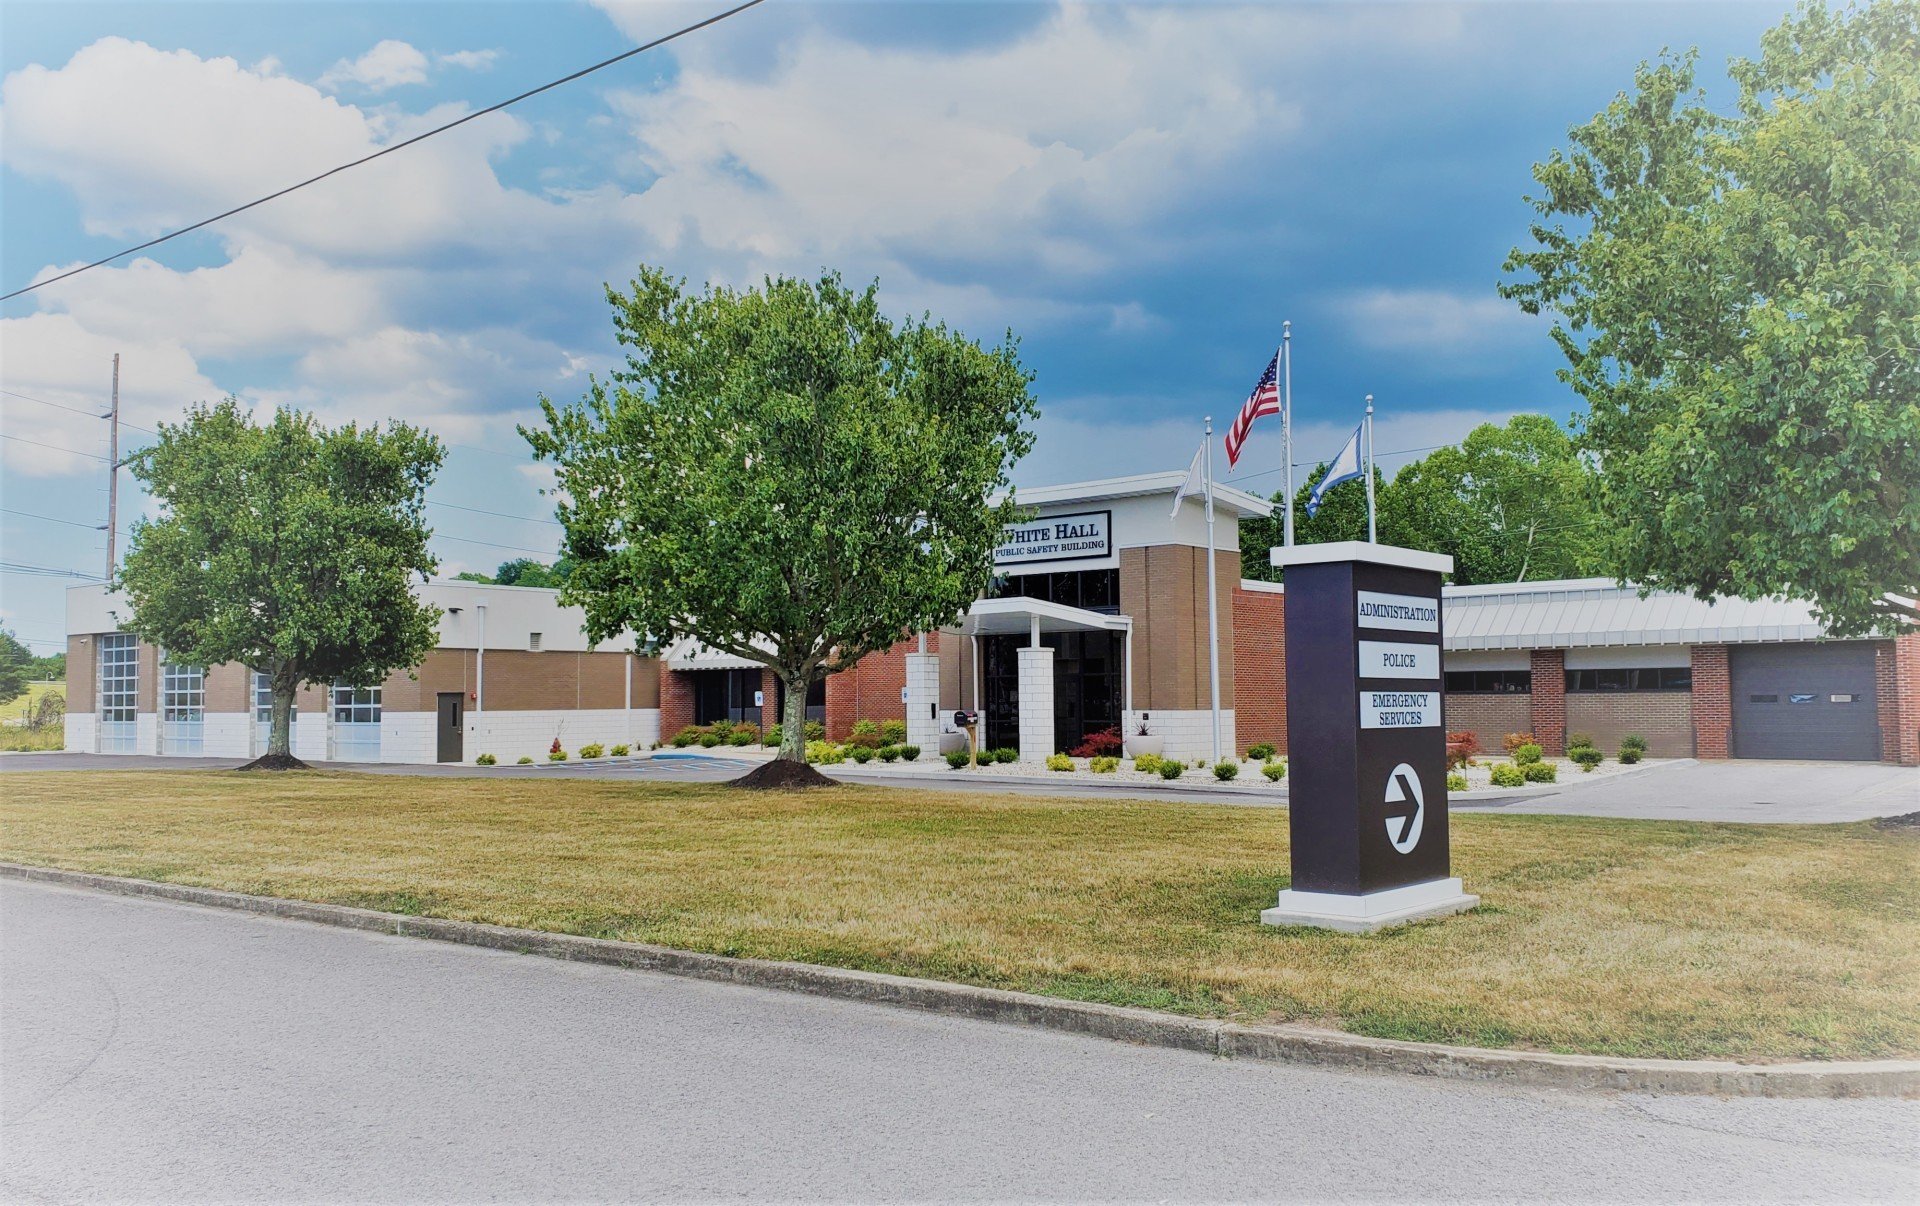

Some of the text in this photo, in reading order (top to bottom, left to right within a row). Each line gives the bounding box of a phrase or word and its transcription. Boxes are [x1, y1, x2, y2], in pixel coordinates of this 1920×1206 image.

[1054, 523, 1099, 540] HALL
[995, 540, 1105, 557] PUBLIC SAFETY BUILDING
[1359, 602, 1436, 622] ADMINISTRATION
[1383, 653, 1416, 668] POLICE
[1372, 693, 1428, 708] EMERGENCY
[1379, 711, 1422, 726] SERVICES
